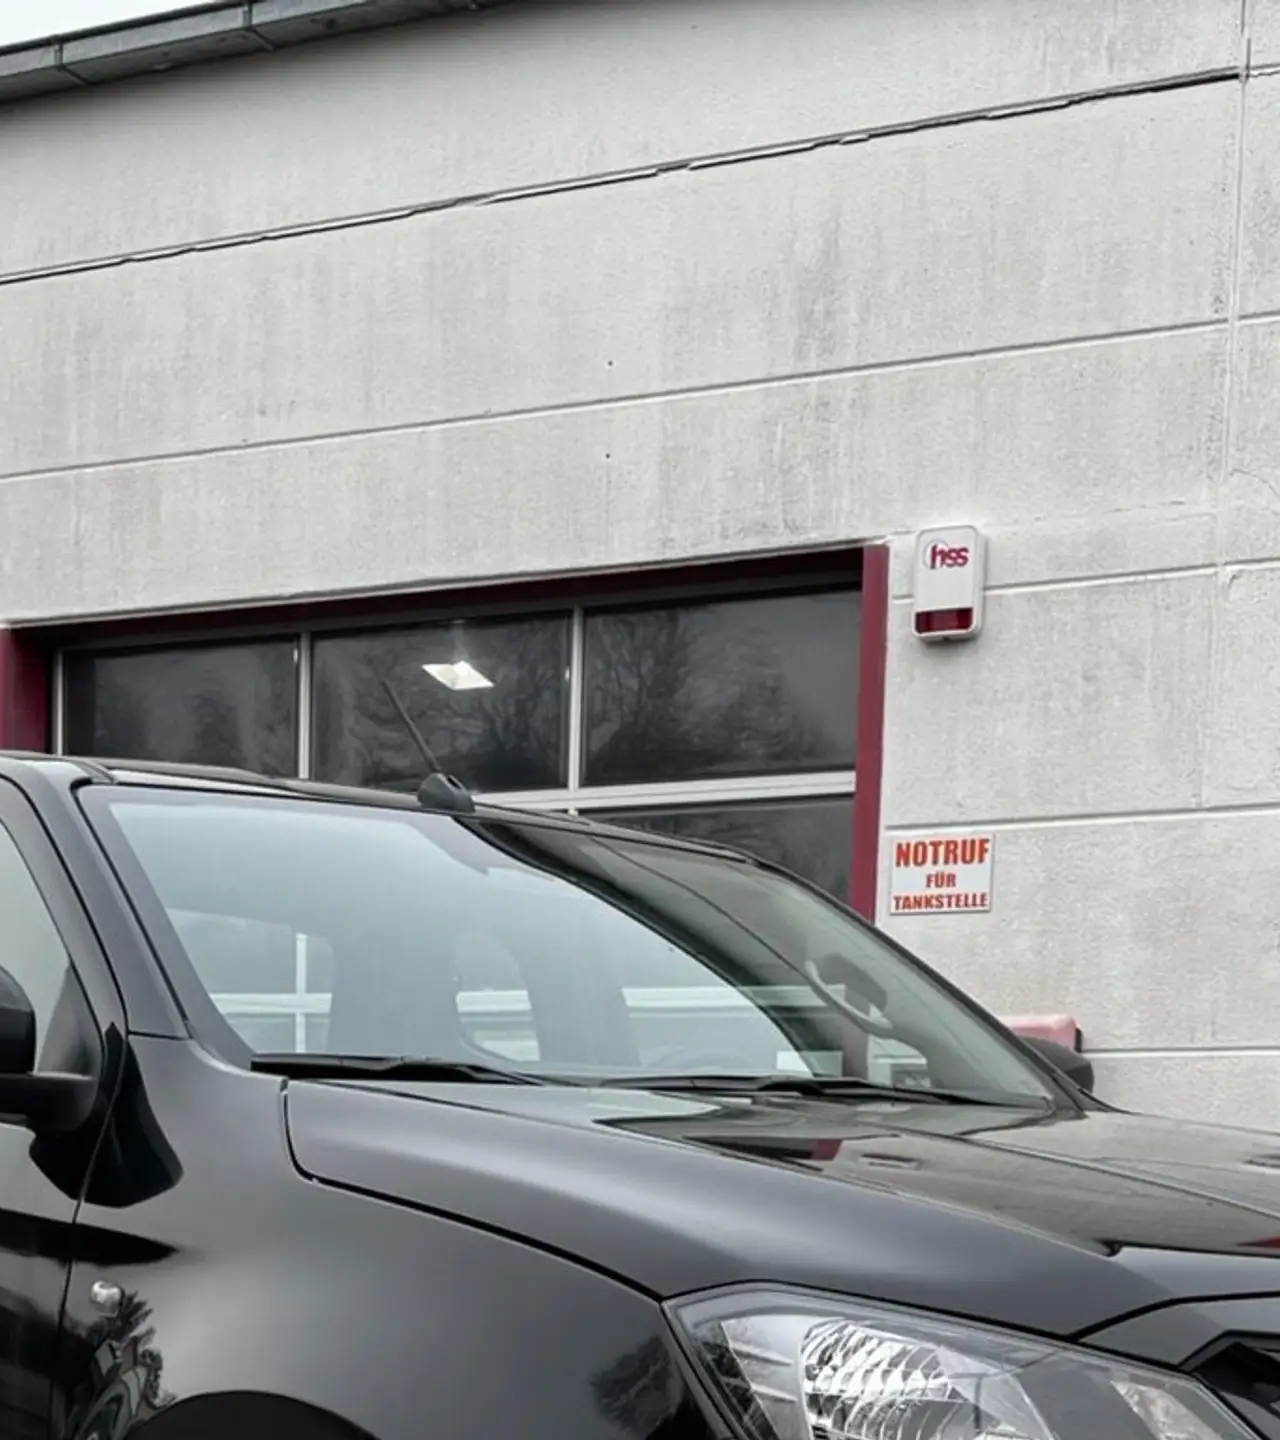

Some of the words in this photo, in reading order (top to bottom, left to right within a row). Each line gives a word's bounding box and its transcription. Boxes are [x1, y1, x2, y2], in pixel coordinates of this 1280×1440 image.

[895, 838, 990, 868] NOTRUF
[925, 870, 957, 889] FÜR
[893, 892, 989, 910] TANKSTELLE
